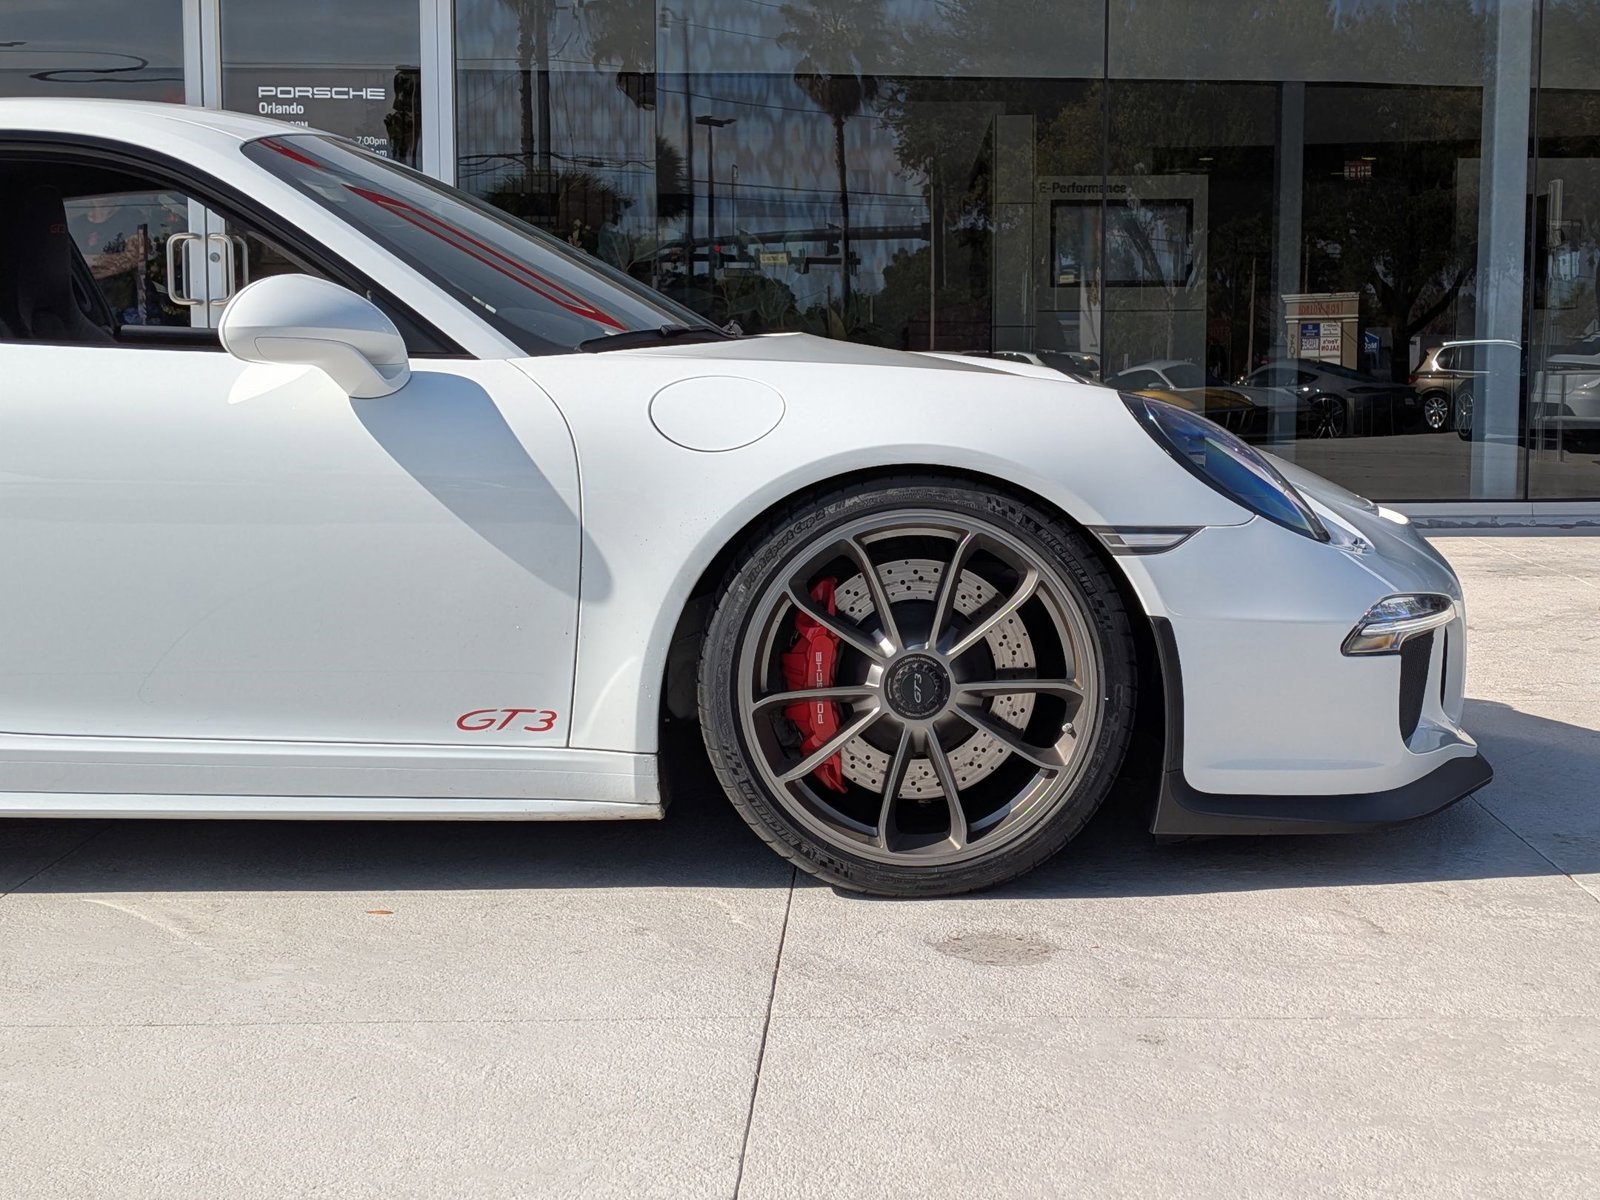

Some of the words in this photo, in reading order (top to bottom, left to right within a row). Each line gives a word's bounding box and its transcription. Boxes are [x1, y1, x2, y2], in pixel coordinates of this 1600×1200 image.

[258, 87, 385, 99] PORSCHE
[259, 102, 304, 114] Orlando
[357, 136, 387, 146] 7:00pm
[1039, 182, 1126, 194] E-Performance
[765, 532, 795, 561] Sport
[793, 514, 815, 534] Cup
[1035, 526, 1097, 596] MICHELIN
[815, 651, 825, 724] POSCHE
[913, 673, 922, 703] GT3
[456, 709, 558, 732] GT3
[737, 779, 800, 847] MICHELIN
